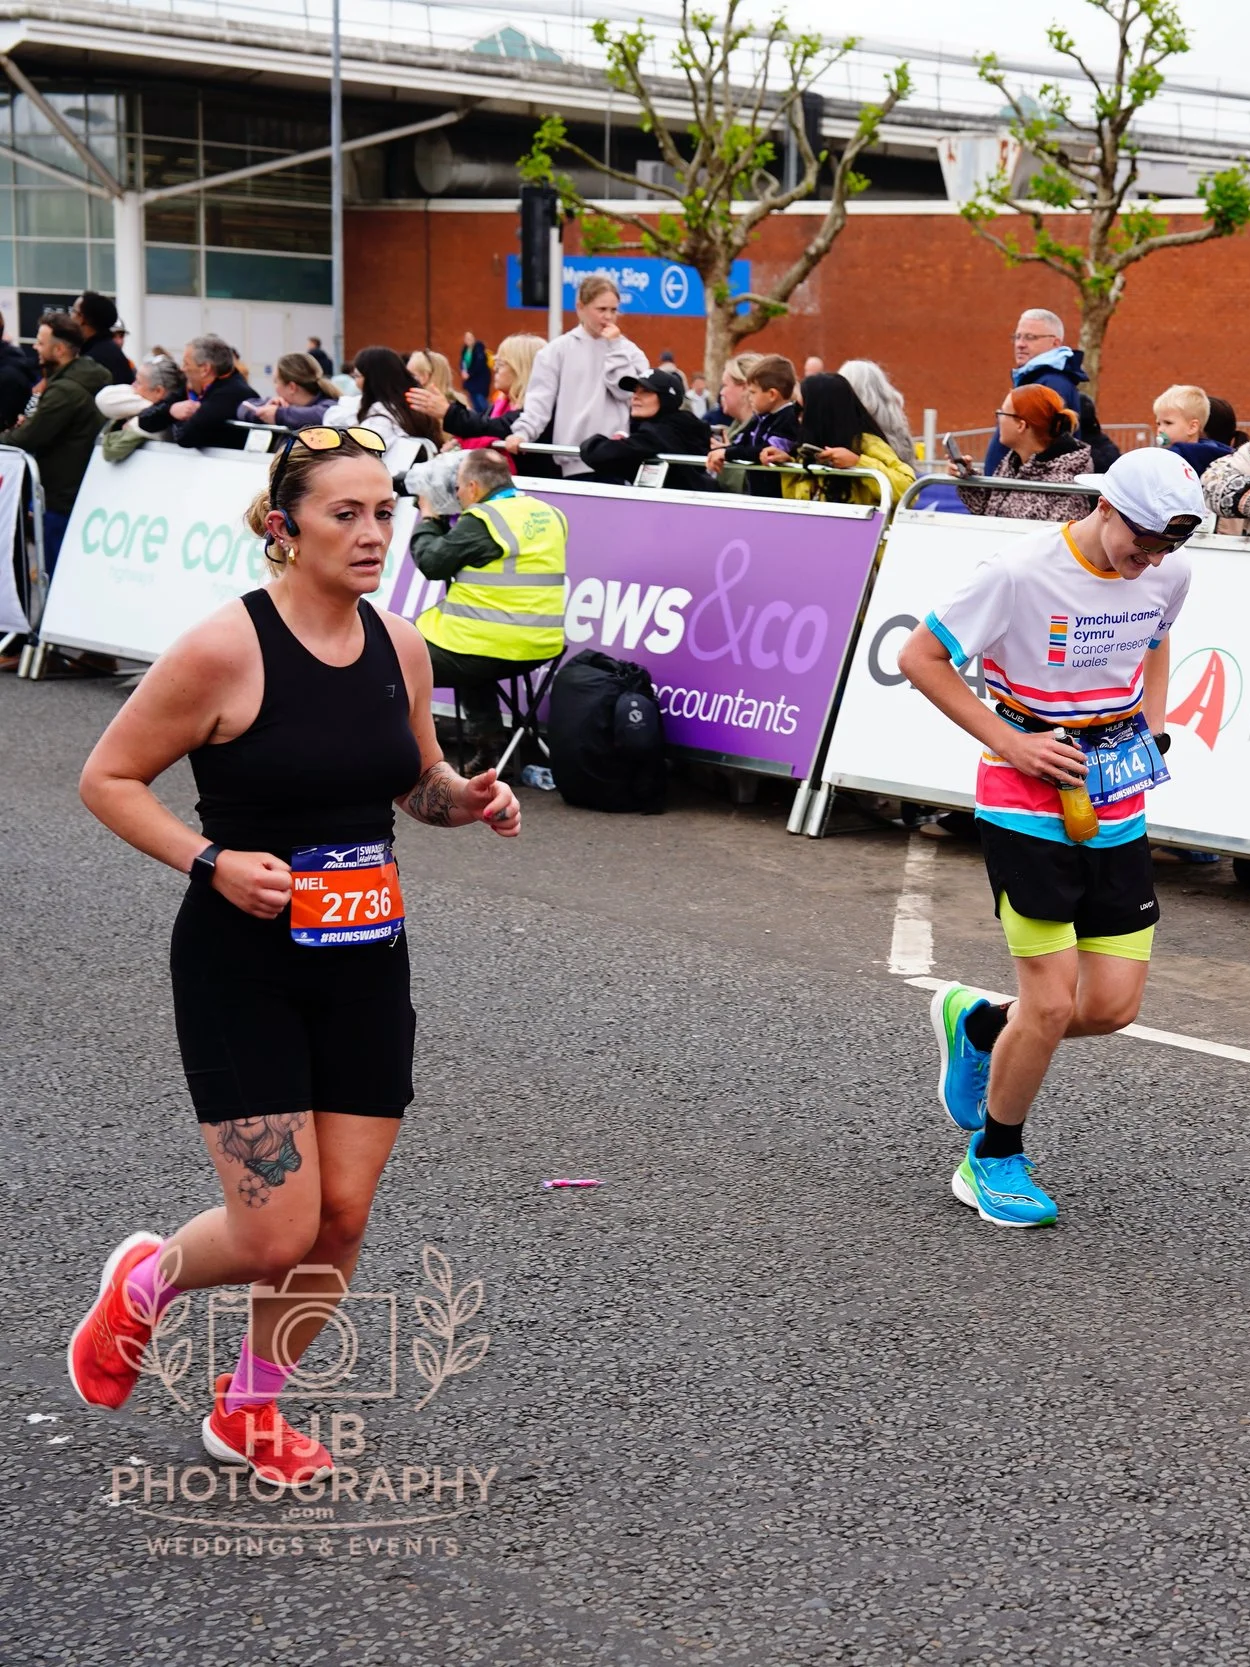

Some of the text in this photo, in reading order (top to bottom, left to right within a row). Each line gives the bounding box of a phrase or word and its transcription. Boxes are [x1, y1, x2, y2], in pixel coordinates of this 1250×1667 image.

[81, 507, 169, 564] core
[1075, 611, 1129, 628] ymchwil
[1073, 629, 1115, 643] cymru
[1072, 642, 1115, 655] cancer
[1071, 656, 1108, 668] wales
[1001, 707, 1025, 724] HUUB
[1105, 721, 1124, 733] HUUB
[1086, 752, 1118, 766] LUCAS
[294, 877, 329, 890] MEL
[321, 887, 391, 922] 2736
[320, 926, 392, 943] #RUNSWANSEA
